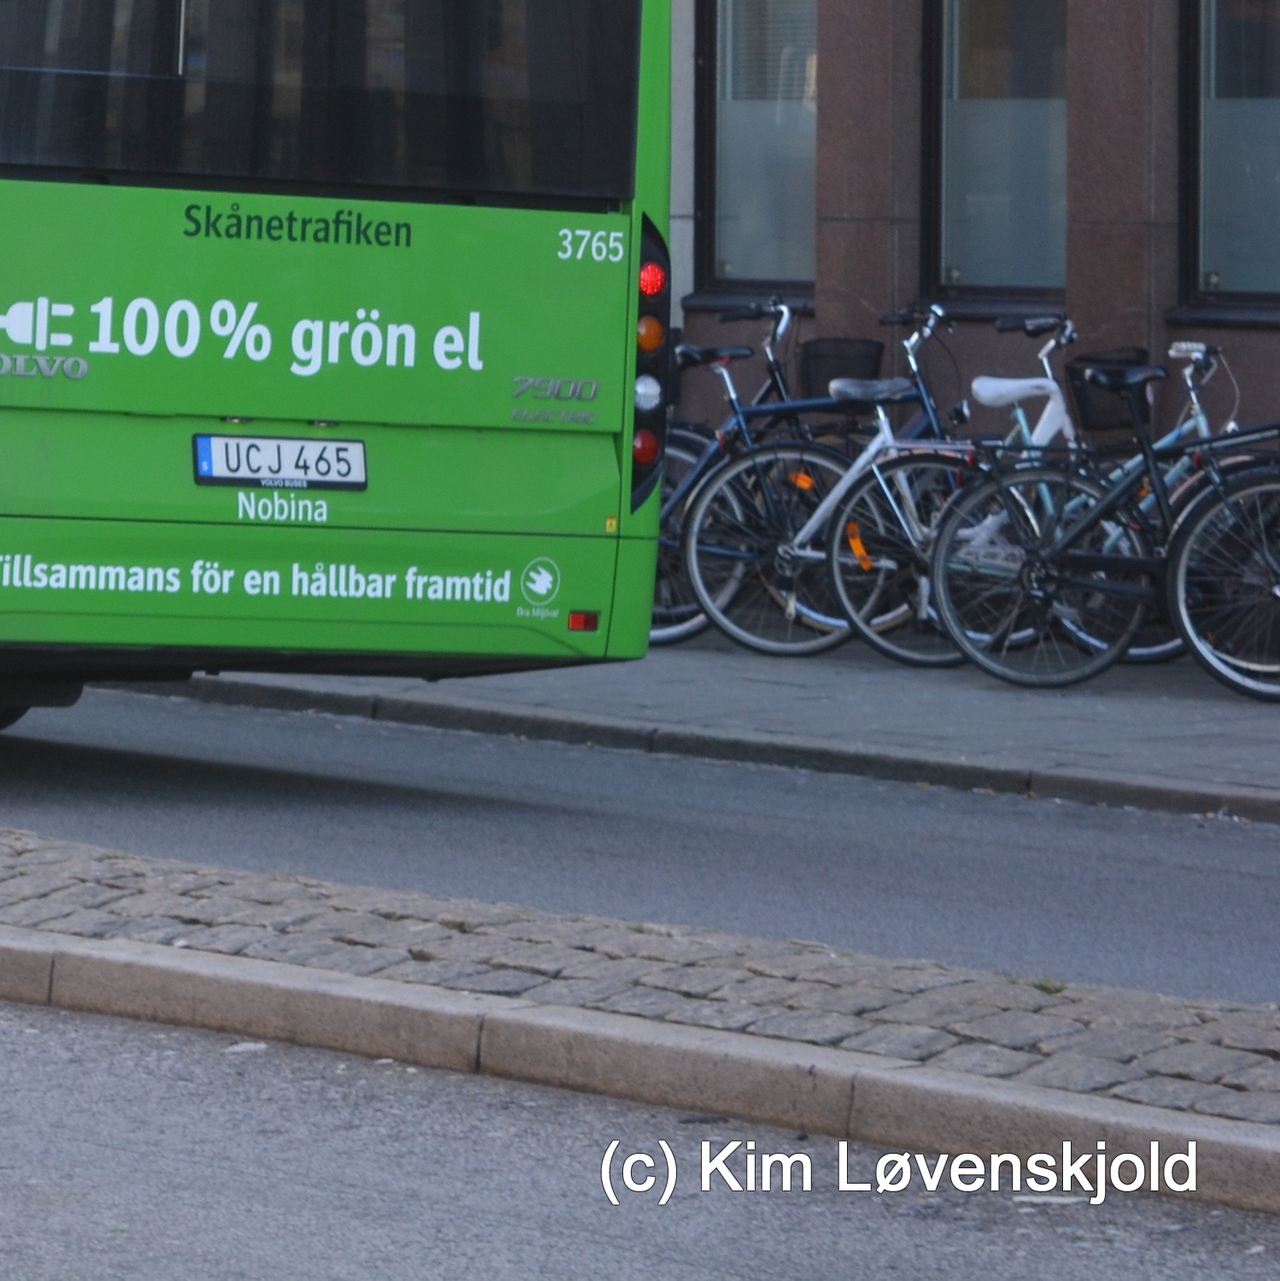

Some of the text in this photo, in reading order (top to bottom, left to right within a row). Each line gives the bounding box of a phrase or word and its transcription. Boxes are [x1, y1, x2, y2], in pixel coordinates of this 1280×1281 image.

[182, 202, 413, 248] Skånetrafiken
[556, 228, 625, 263] 3765
[87, 296, 483, 376] 100% grön el
[512, 376, 598, 401] 7900
[224, 442, 352, 477] UCJ 465
[261, 478, 308, 489] VOLVO BUSES
[237, 491, 328, 522] Nobina
[191, 560, 235, 595] för
[243, 568, 281, 596] en
[291, 562, 397, 599] hållbar
[405, 566, 511, 603] framtid
